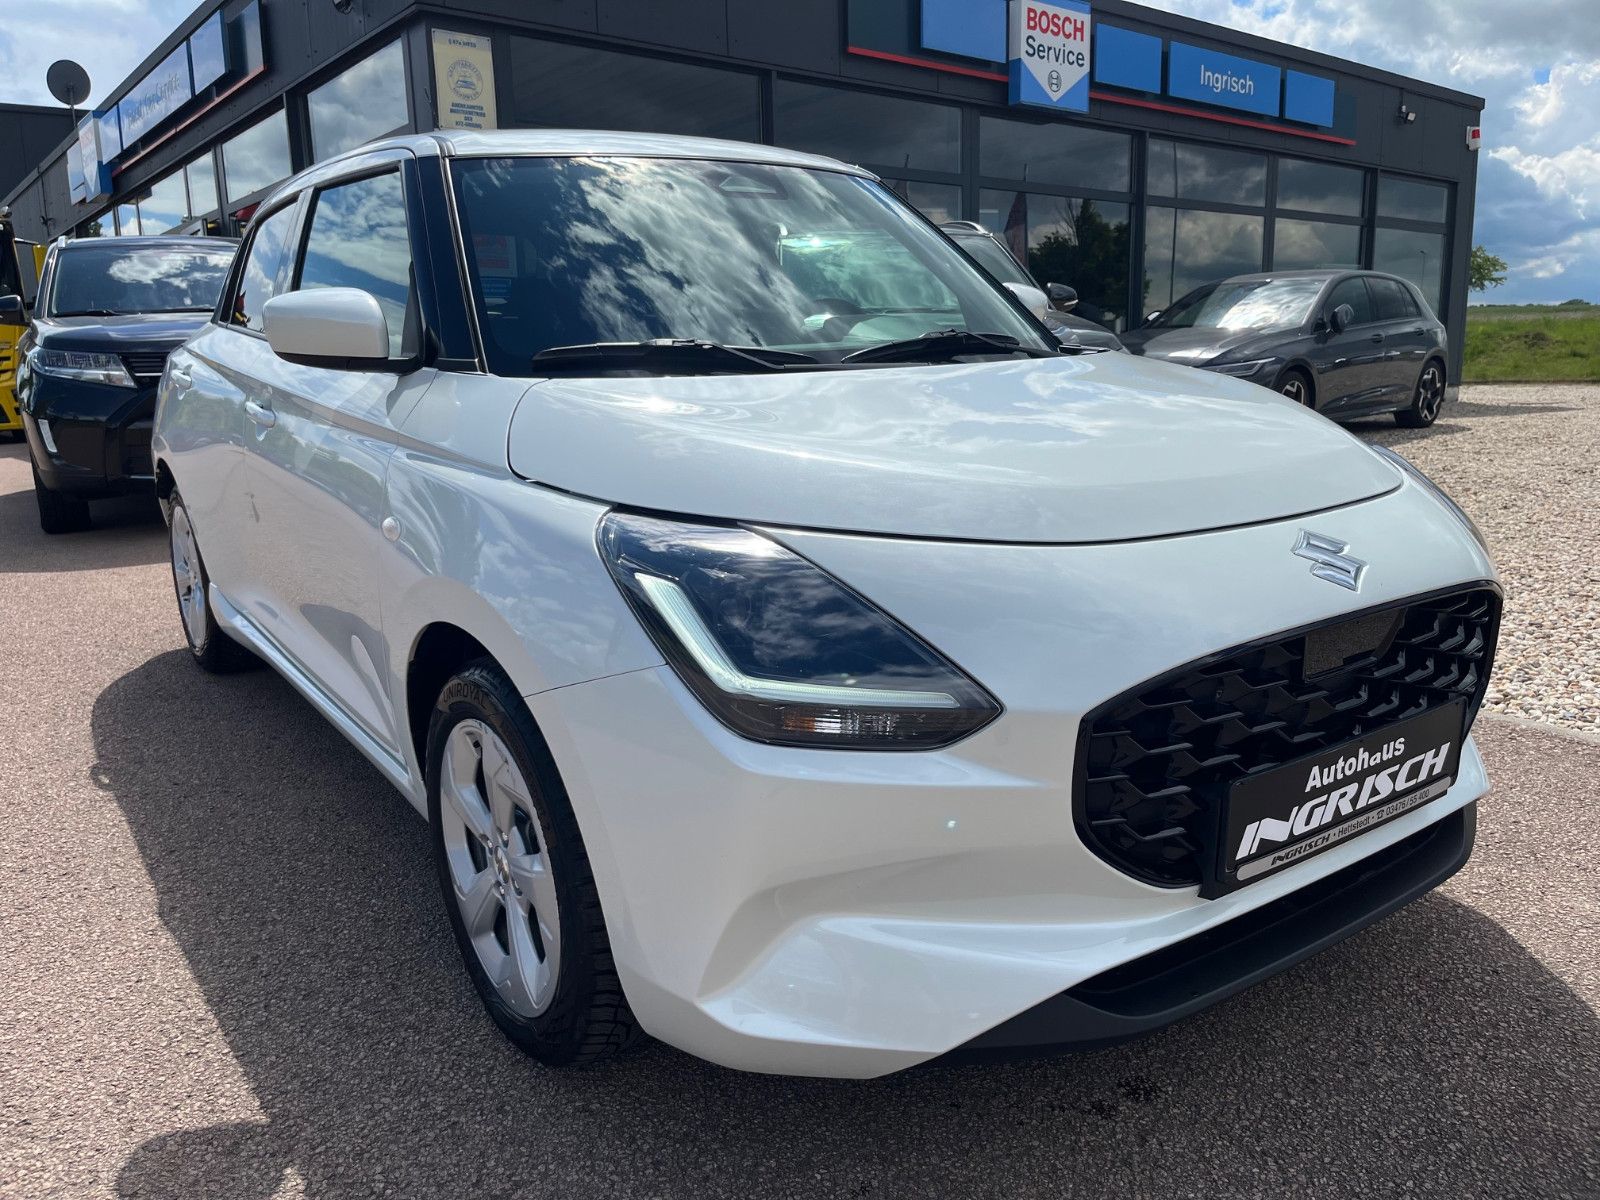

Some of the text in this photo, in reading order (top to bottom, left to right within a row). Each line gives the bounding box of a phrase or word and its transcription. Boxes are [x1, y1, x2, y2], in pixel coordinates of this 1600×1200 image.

[1027, 7, 1085, 42] BOSCH
[1025, 35, 1085, 67] Service
[1200, 64, 1254, 96] Ingrisch
[443, 682, 488, 711] UNIROYAL
[1304, 737, 1405, 792] Autohaus
[1235, 742, 1451, 860] INGRISCH
[1271, 833, 1331, 866] INGRISCH
[1338, 816, 1370, 837] Hettstedt
